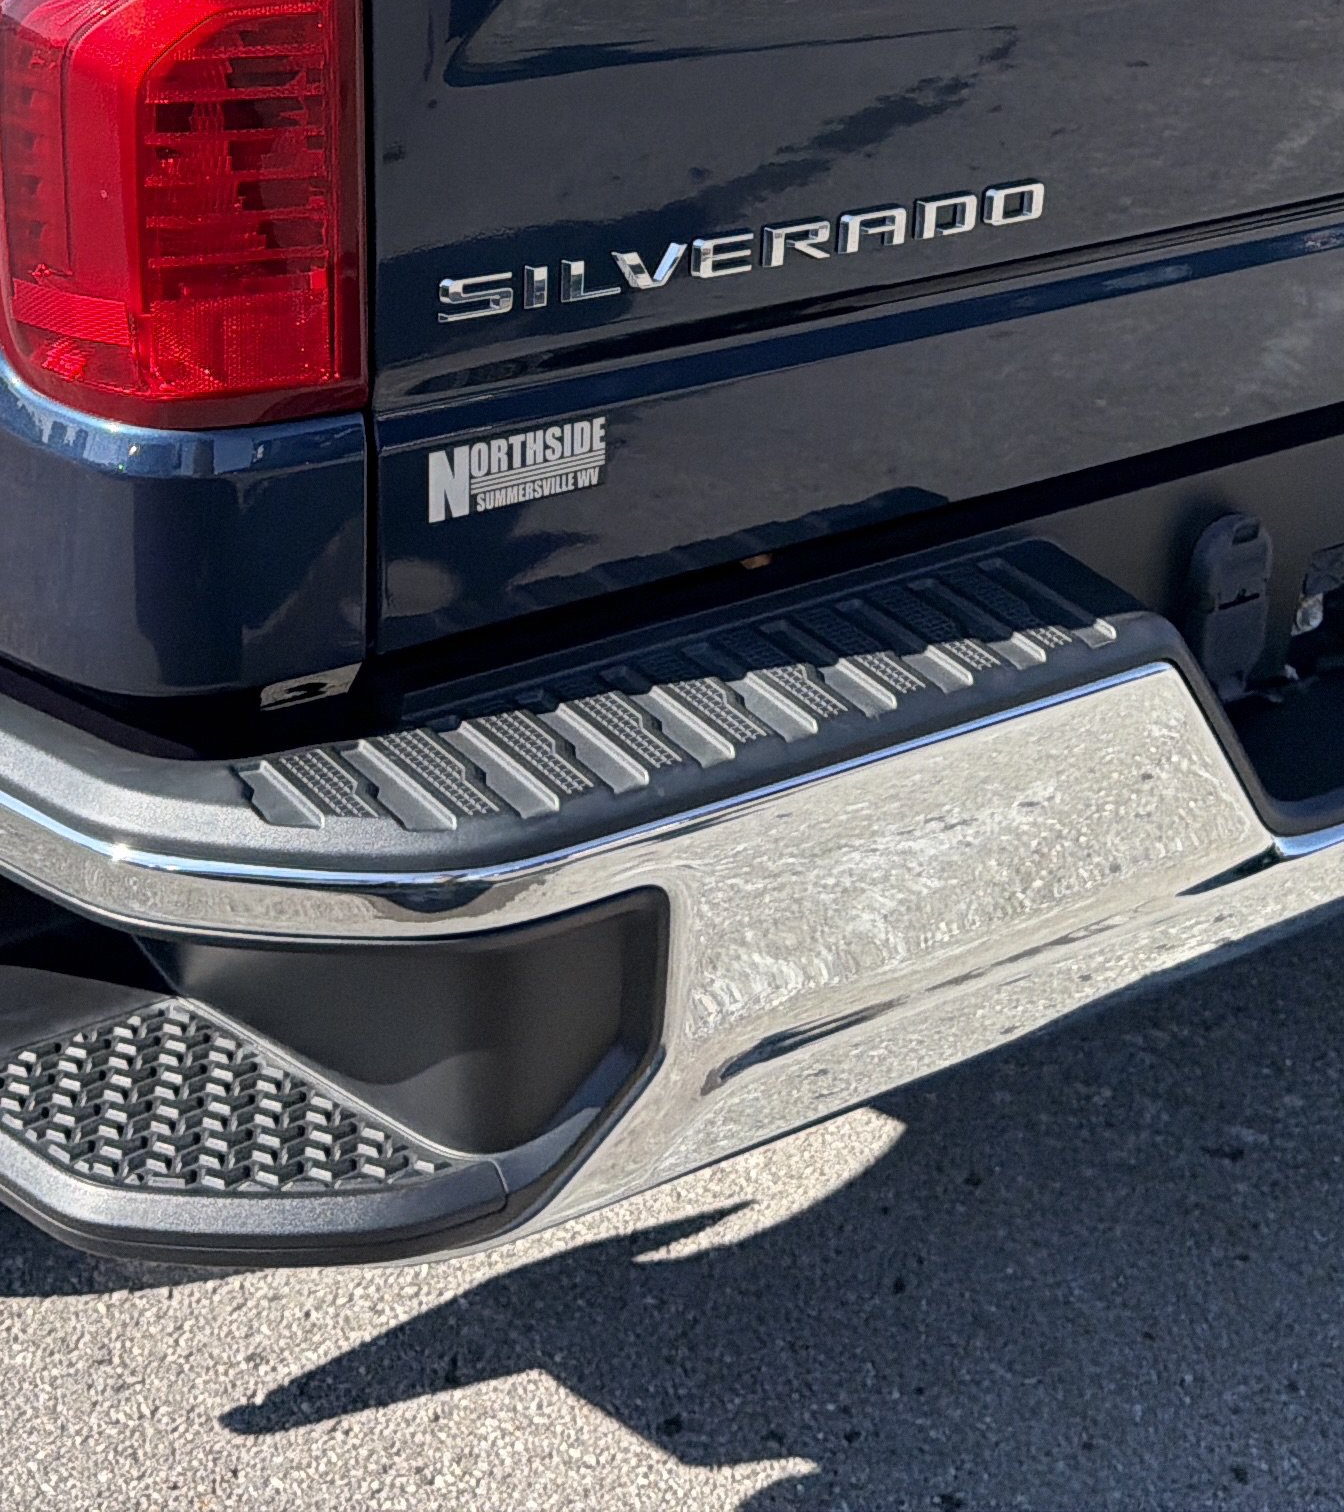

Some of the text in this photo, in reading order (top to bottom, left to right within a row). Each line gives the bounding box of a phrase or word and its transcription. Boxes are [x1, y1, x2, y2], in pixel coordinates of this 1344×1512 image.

[436, 179, 1046, 324] SILVERADO
[428, 416, 606, 524] NORTHSIDE
[476, 466, 600, 513] SUMMERSVILLE WV
